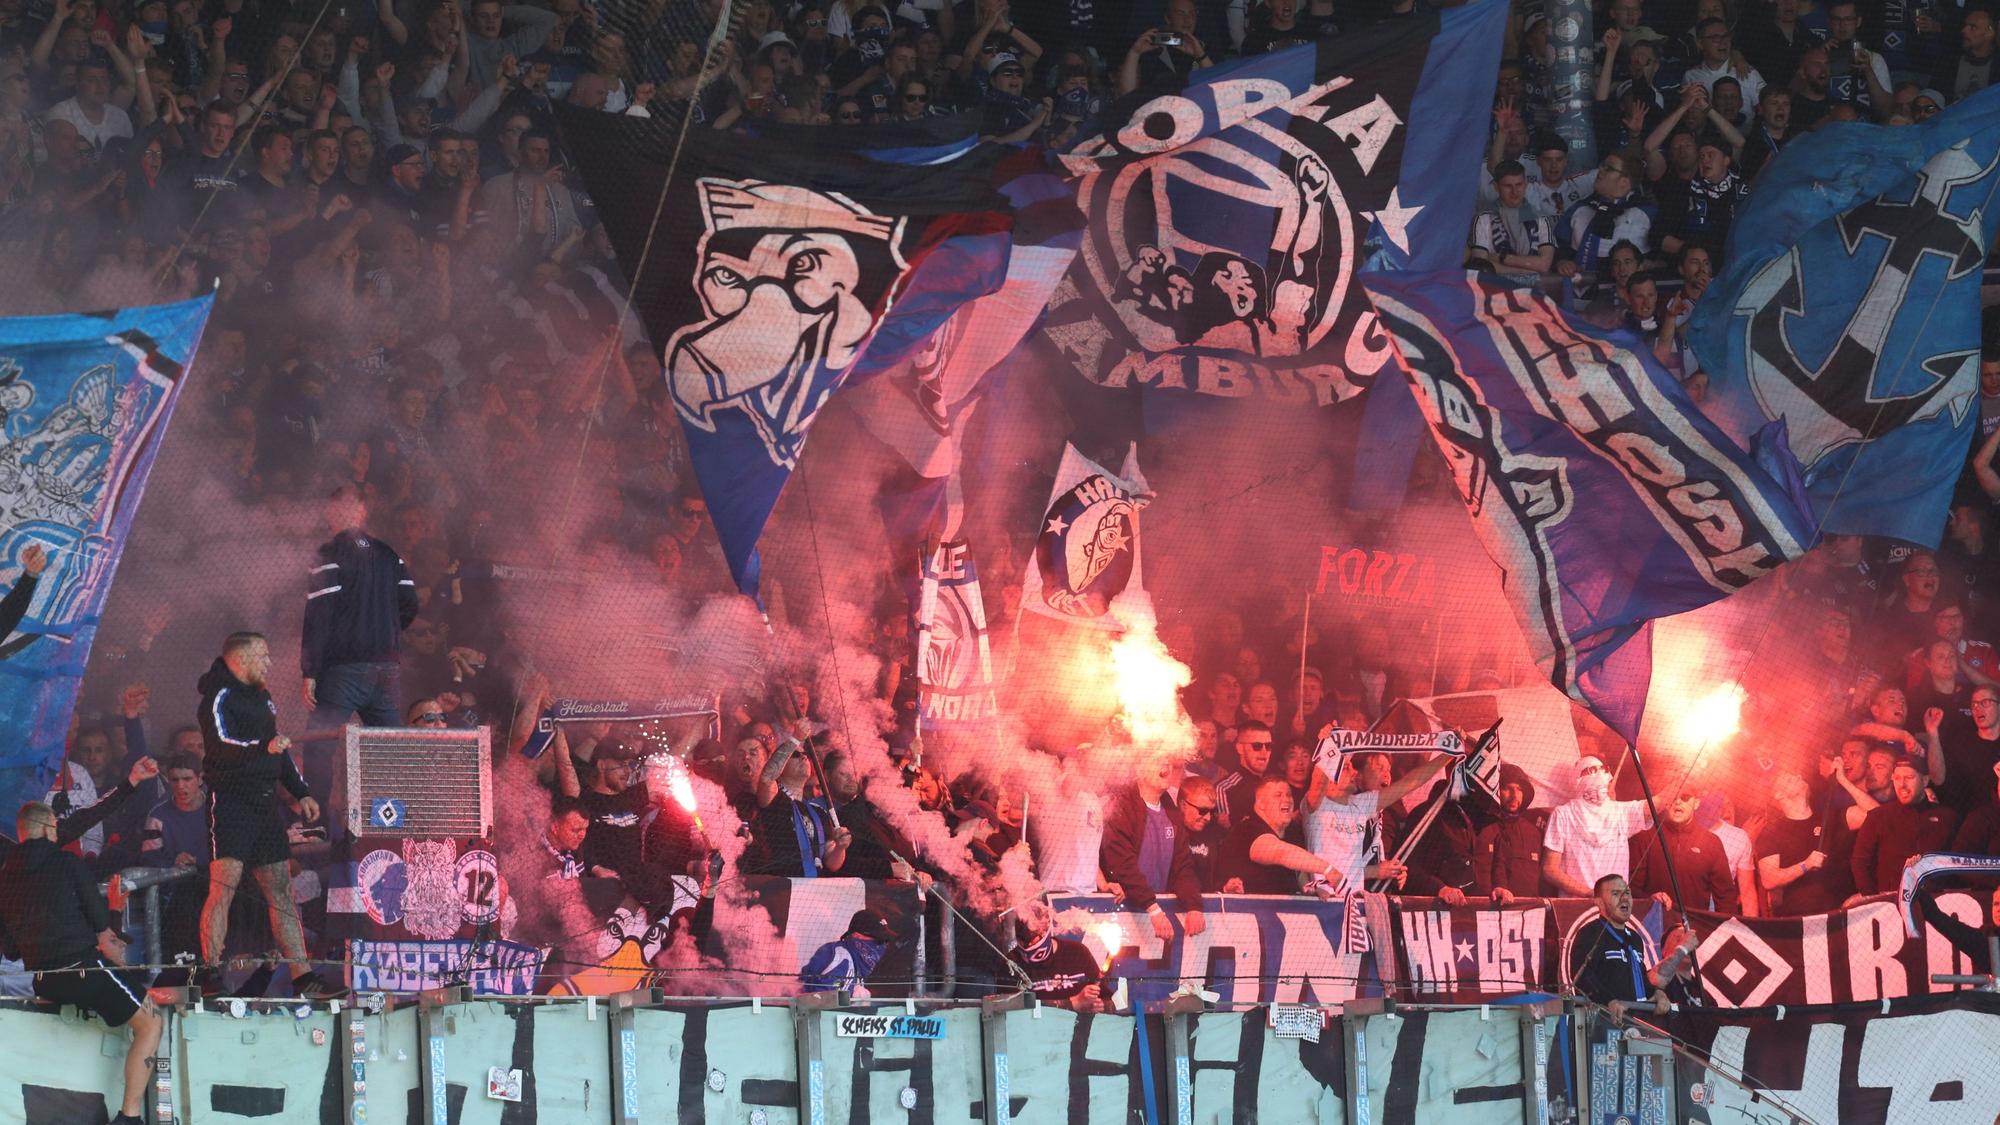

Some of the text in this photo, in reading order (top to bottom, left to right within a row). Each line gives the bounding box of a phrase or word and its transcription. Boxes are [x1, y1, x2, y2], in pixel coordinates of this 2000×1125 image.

[1315, 546, 1436, 608] FORZA
[559, 698, 629, 716] Hansestadt
[464, 869, 496, 907] 12
[1402, 908, 1546, 1000] HH OST
[842, 1016, 942, 1037] SCHEISS ST.PAULI
